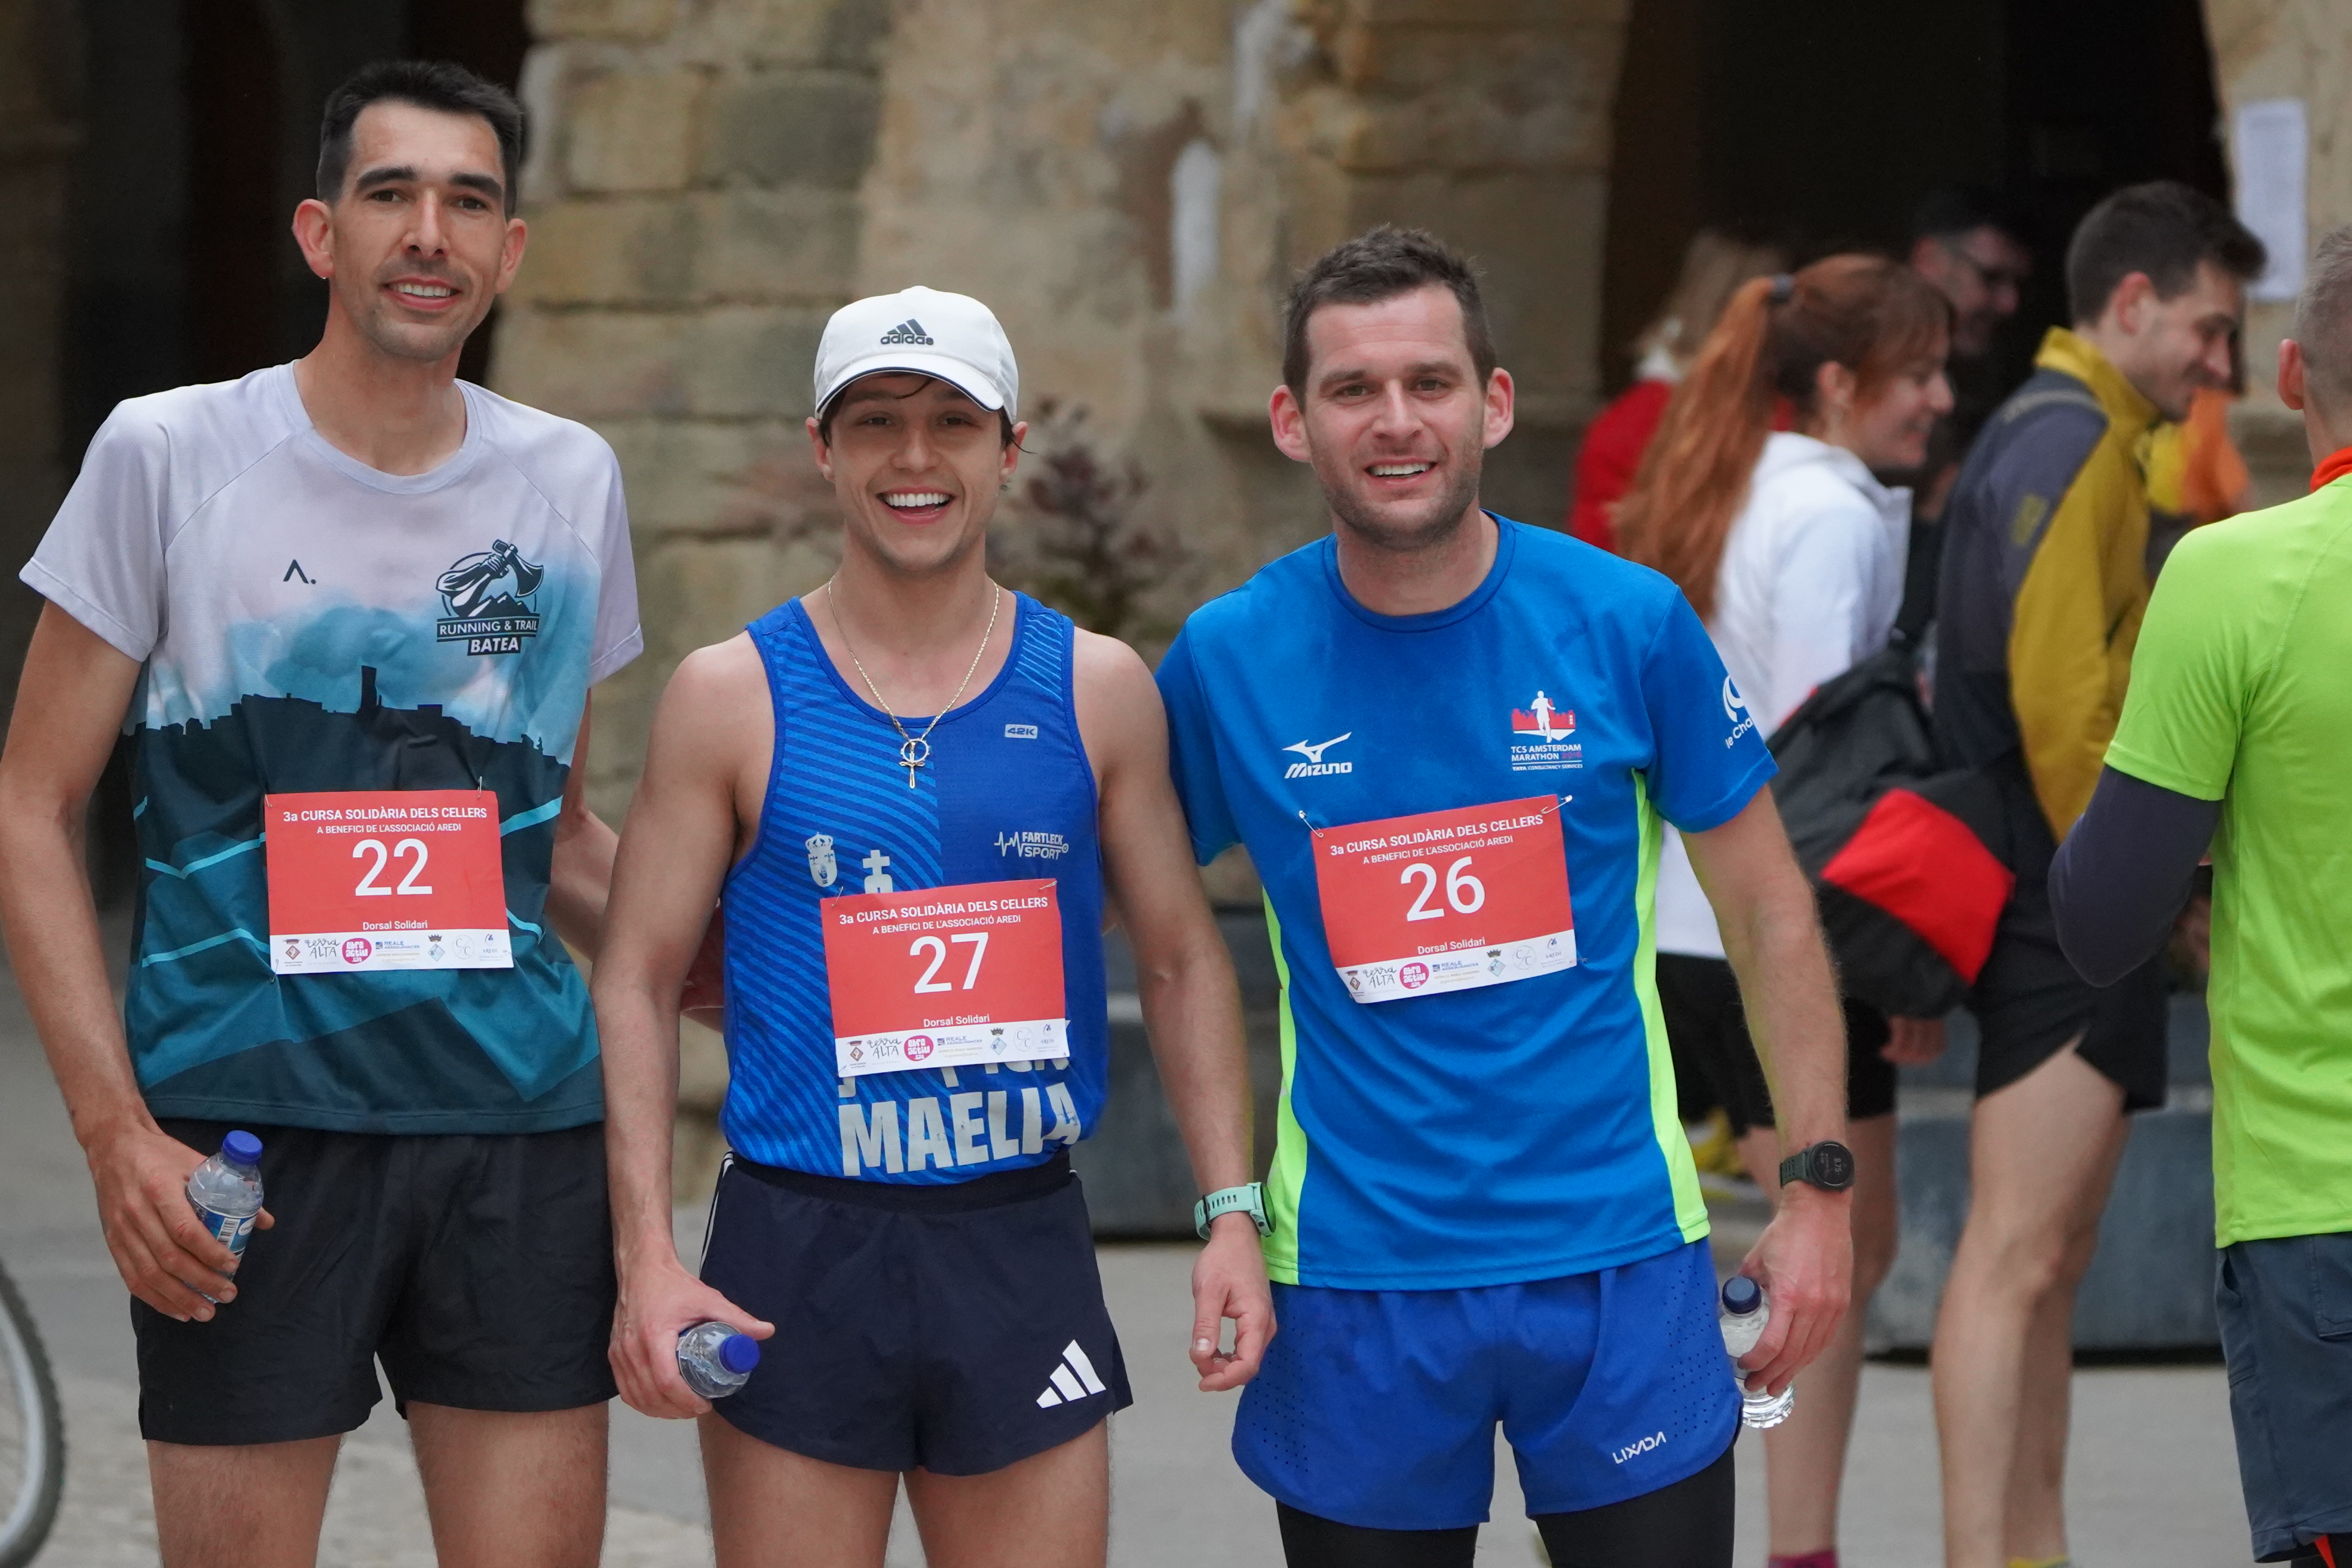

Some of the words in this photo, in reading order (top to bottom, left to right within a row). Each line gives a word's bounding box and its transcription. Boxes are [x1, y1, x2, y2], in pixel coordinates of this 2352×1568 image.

[880, 333, 934, 345] adidas
[439, 620, 501, 635] RUNNING
[504, 620, 512, 630] &
[514, 620, 537, 631] TRAIL
[470, 636, 519, 653] BATEA
[1007, 727, 1036, 736] 42K
[1529, 744, 1582, 753] AMSTERDAM
[1511, 752, 1559, 761] MARATHON
[1284, 762, 1352, 779] MIZUNO
[283, 811, 298, 822] 3a
[301, 809, 343, 821] CURSA
[345, 806, 408, 820] SOLIDÀRIA
[410, 807, 439, 819] DELS
[441, 807, 487, 818] CELLERS
[317, 826, 324, 834] A
[325, 825, 365, 834] BENEFICI
[366, 824, 378, 833] DE
[436, 823, 461, 831] AREDI
[1330, 845, 1345, 856] 3a
[1346, 837, 1388, 853] CURSA
[1389, 828, 1455, 847] SOLIDÀRIA
[1456, 823, 1488, 837] DELS
[1490, 814, 1544, 832] CELLERS
[1022, 832, 1063, 846] FARTLECK
[1025, 846, 1061, 860] SPORT
[1363, 856, 1370, 865] A
[1371, 850, 1411, 863] BENEFICI
[1412, 848, 1425, 858] DE
[1487, 835, 1514, 846] AREDI
[352, 838, 433, 896] 22
[1400, 856, 1486, 922] 26
[839, 914, 854, 925] 3a
[856, 908, 899, 923] CURSA
[900, 902, 966, 918] SOLIDÀRIA
[967, 900, 998, 912] DELS
[1000, 896, 1048, 910] CELLERS
[362, 920, 392, 930] Dorsal
[394, 920, 428, 930] Solidari
[872, 926, 880, 935] A
[881, 922, 921, 934] BENEFICI
[922, 921, 935, 930] DE
[996, 914, 1021, 924] AREDI
[310, 947, 337, 959] ALTA
[1417, 942, 1448, 955] Dorsal
[1450, 936, 1486, 950] Solidari
[909, 932, 989, 994] 27
[1369, 974, 1395, 988] ALTA
[923, 1016, 954, 1028] Dorsal
[955, 1013, 990, 1025] Solidari
[872, 1045, 899, 1059] ALTA
[1612, 1431, 1667, 1464] LIXADA
